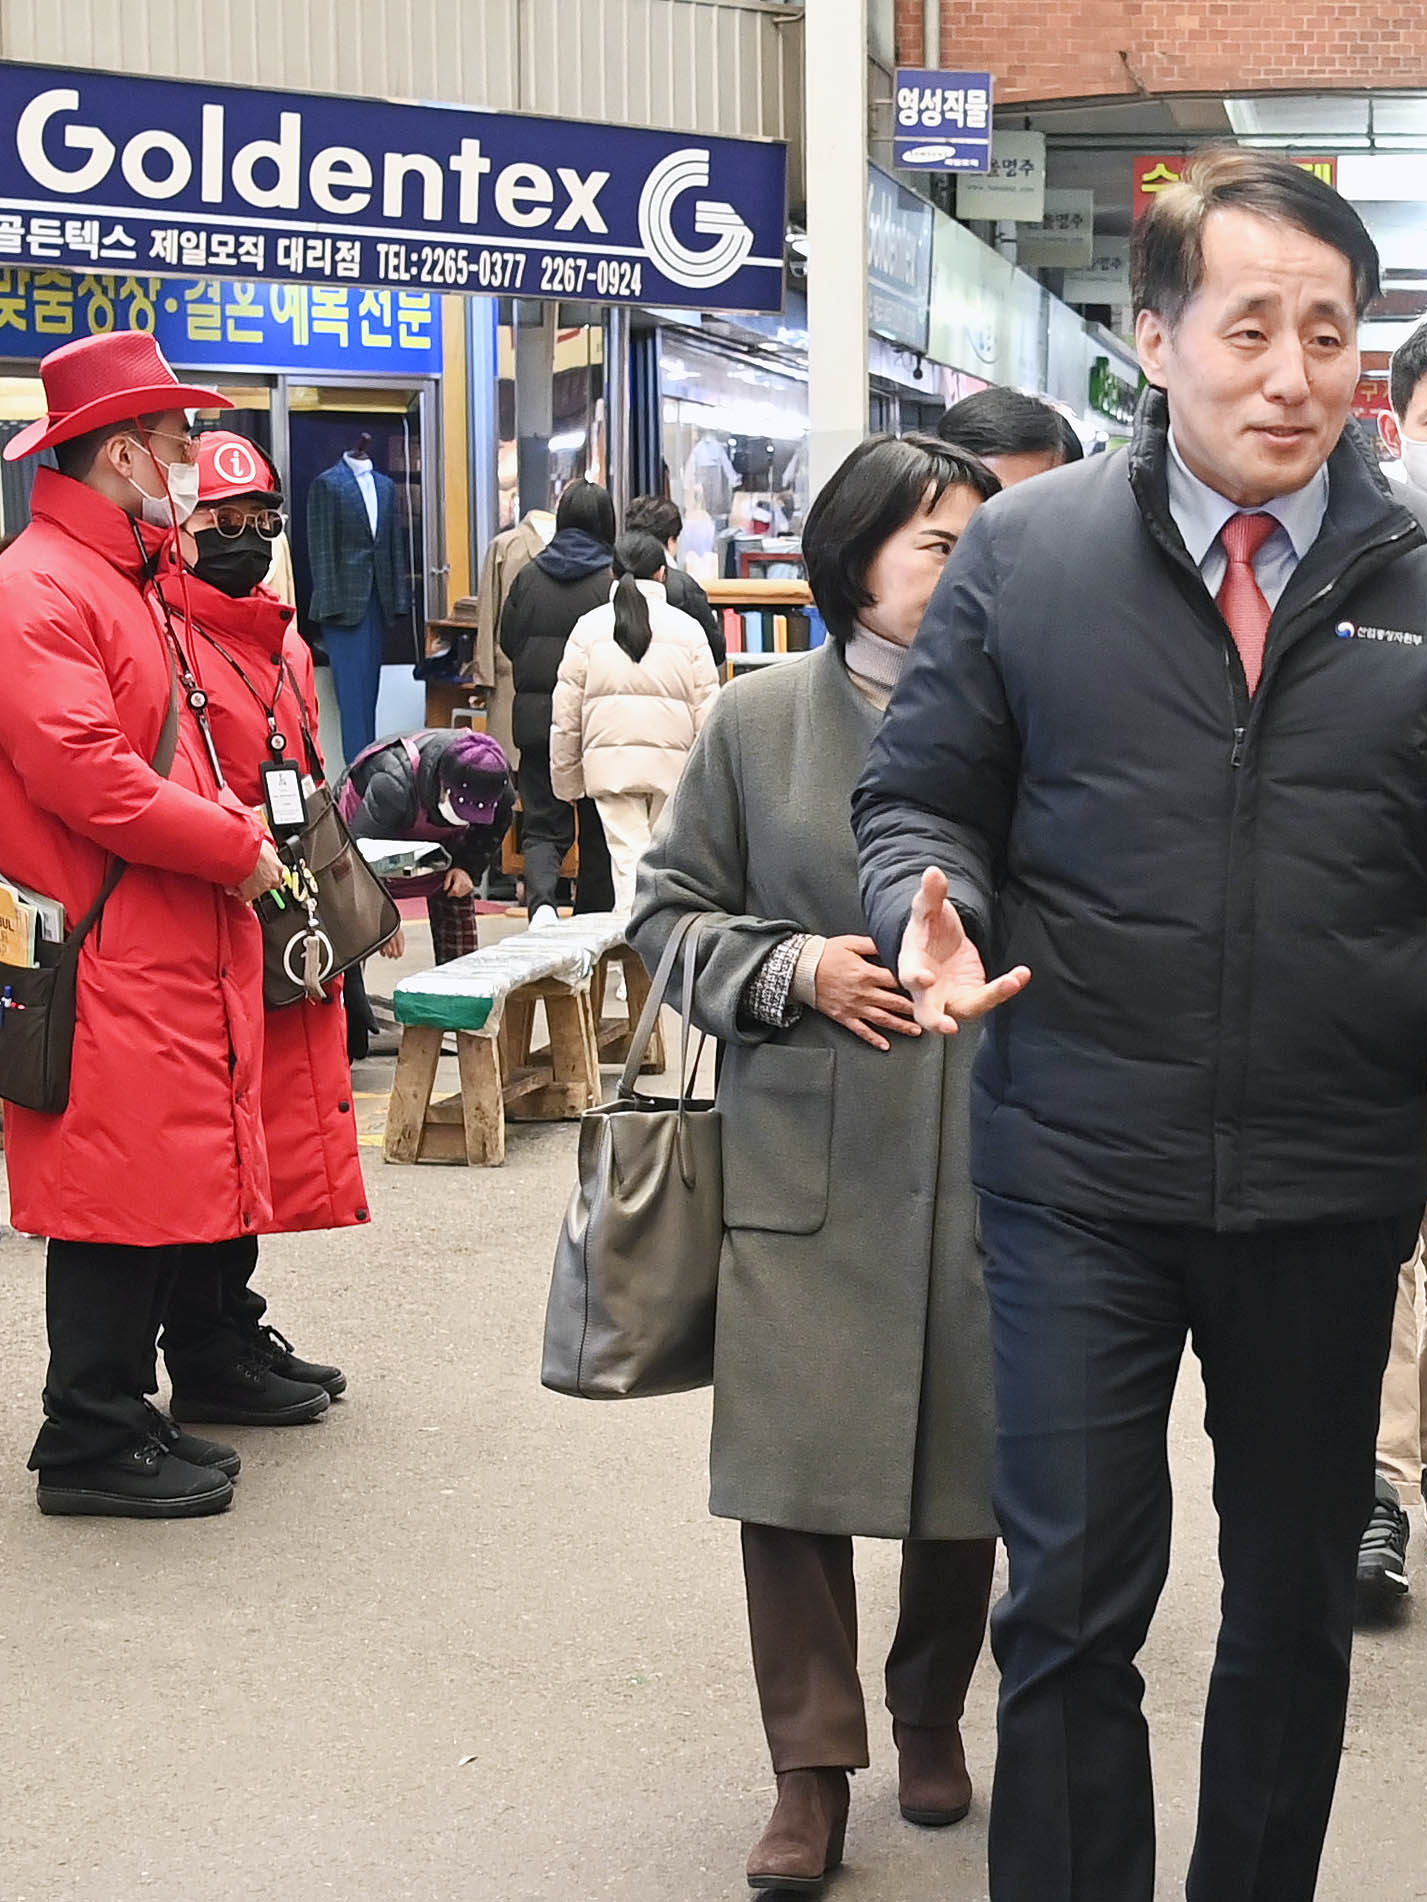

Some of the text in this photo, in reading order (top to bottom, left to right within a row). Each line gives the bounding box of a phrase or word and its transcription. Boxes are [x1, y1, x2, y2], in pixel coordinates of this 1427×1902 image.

[897, 87, 989, 129] 영성직물
[16, 88, 610, 235] Goldentex
[0, 214, 643, 297] 골든텍스 제일모직 대리점 TEL:2265-0377 2267-0924
